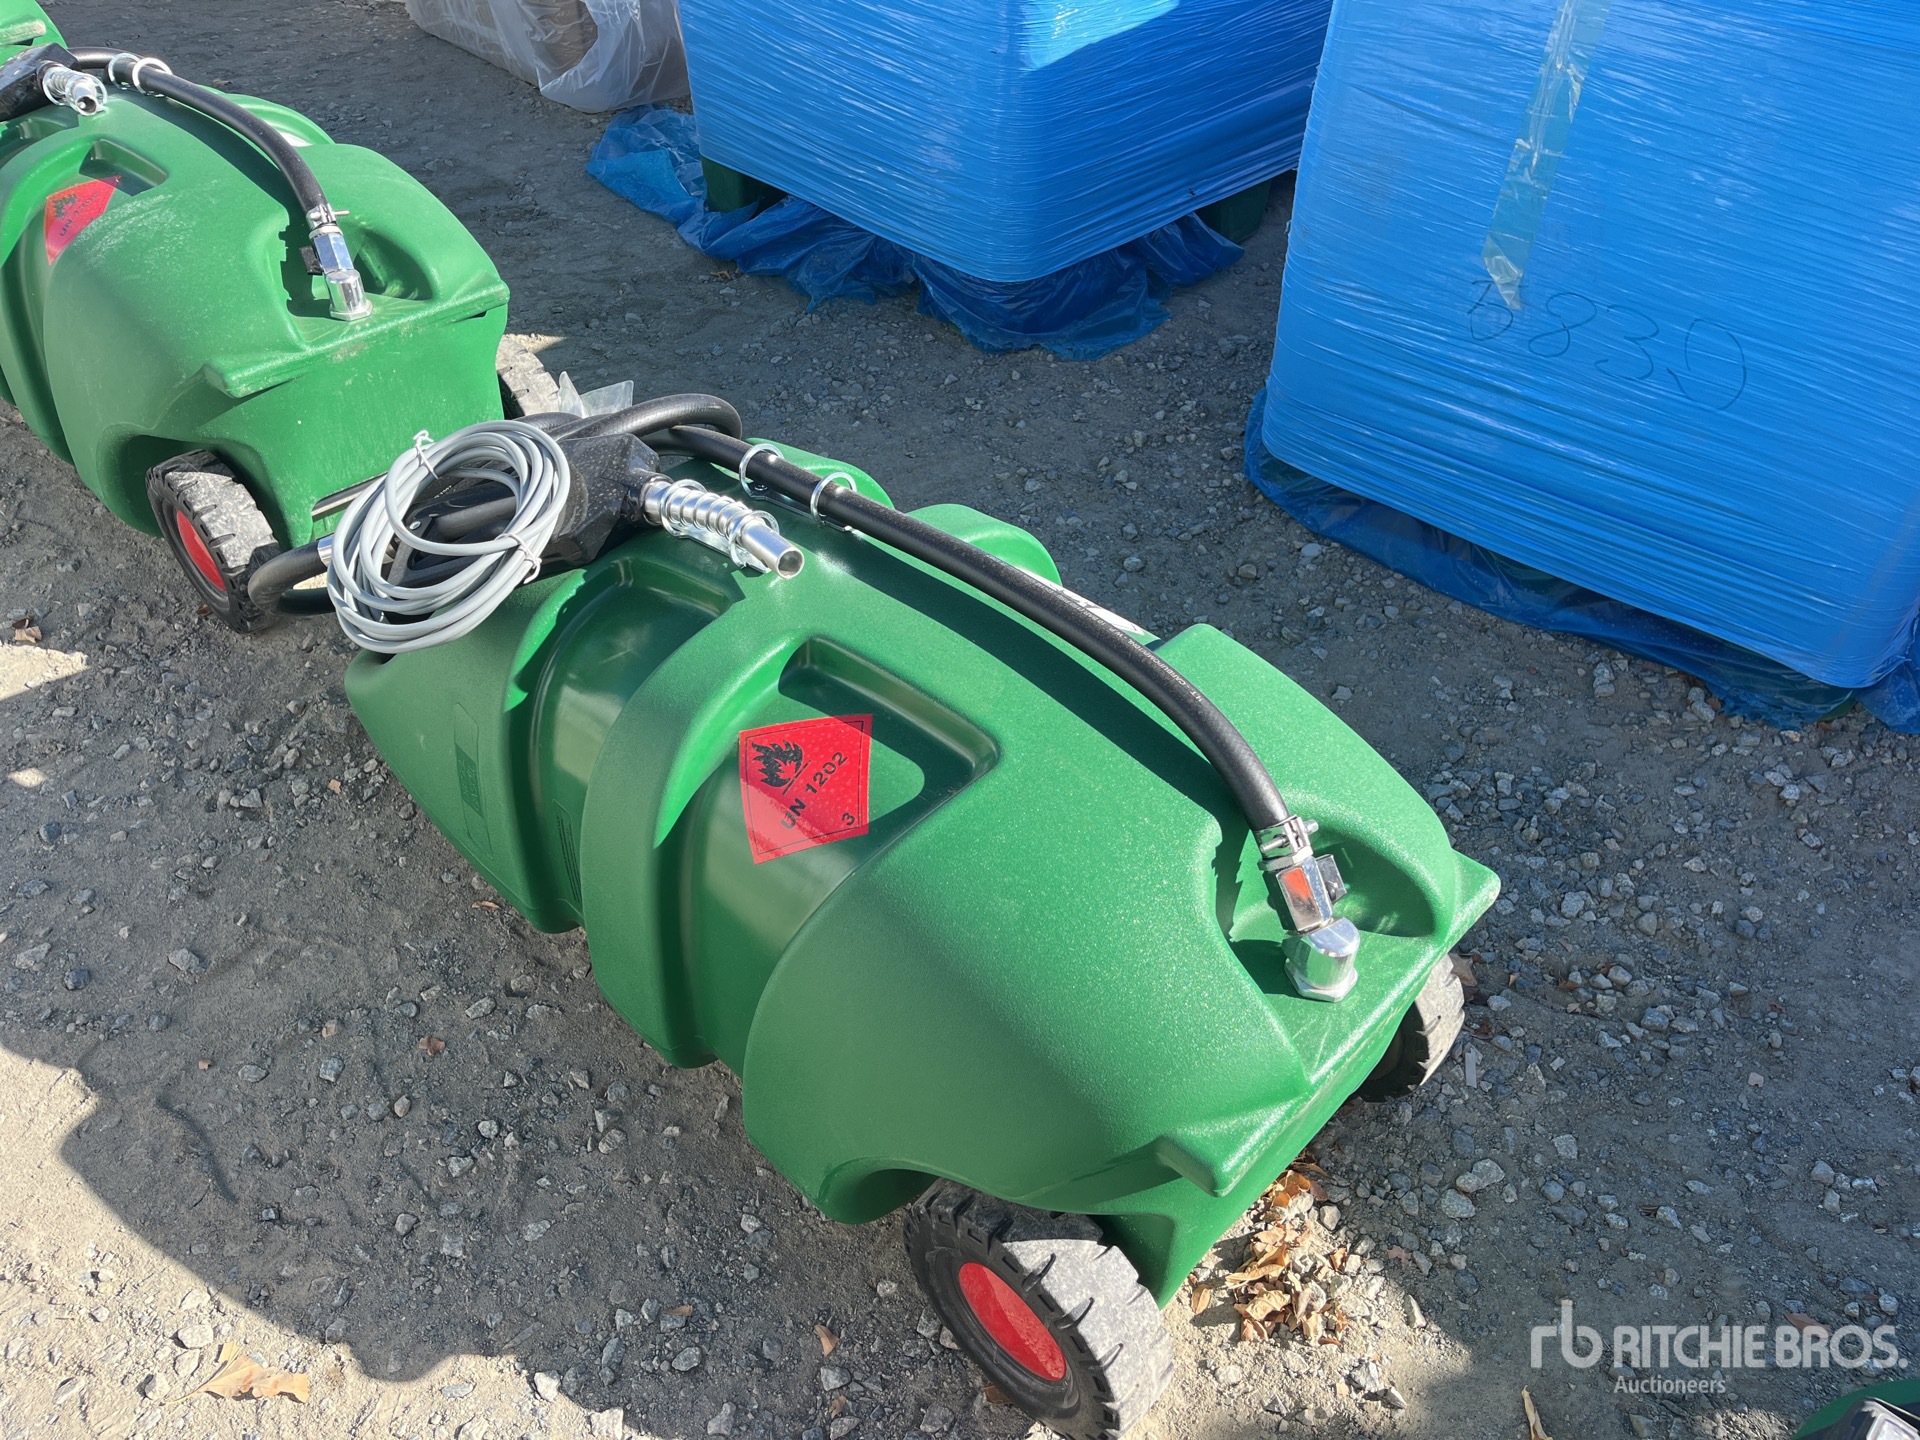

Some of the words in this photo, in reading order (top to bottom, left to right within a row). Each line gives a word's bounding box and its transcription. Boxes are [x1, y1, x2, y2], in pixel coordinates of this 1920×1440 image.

[781, 798, 806, 829] UN
[806, 751, 848, 794] 1202
[841, 812, 856, 826] 3
